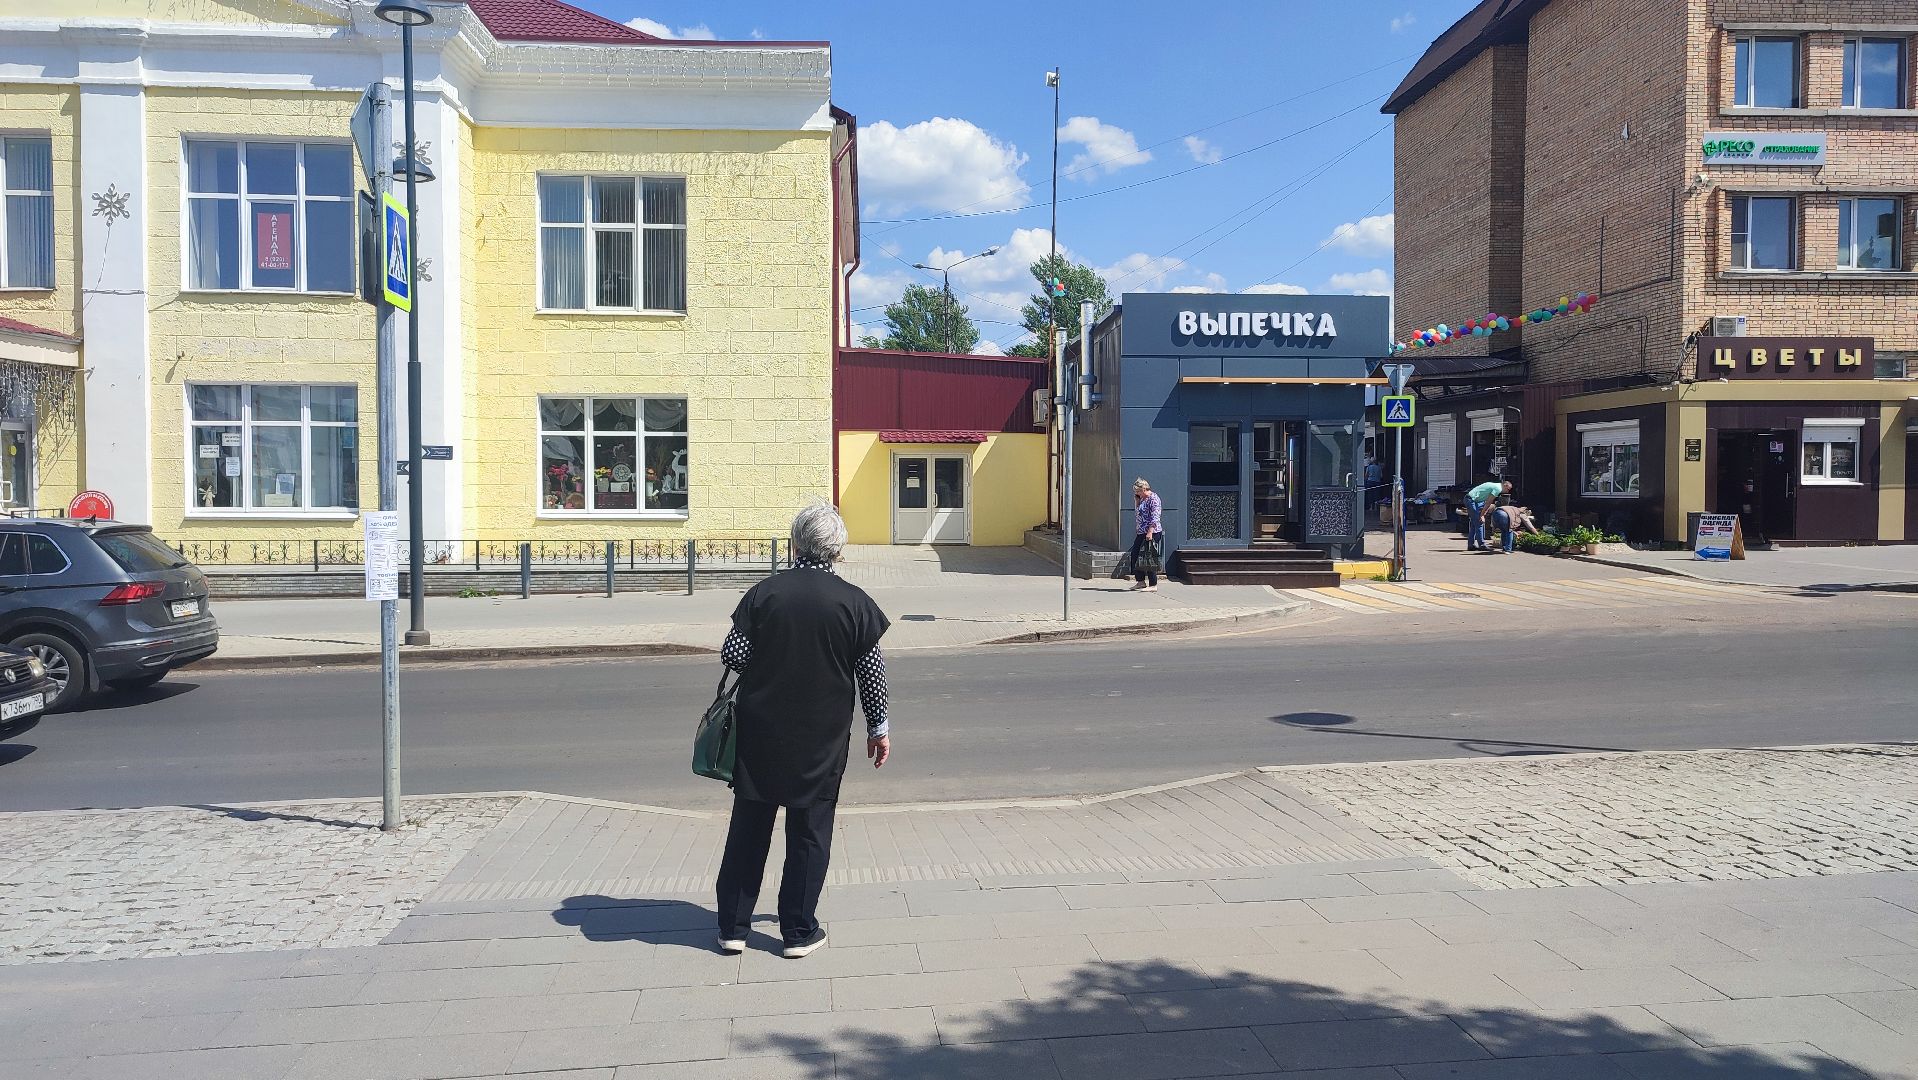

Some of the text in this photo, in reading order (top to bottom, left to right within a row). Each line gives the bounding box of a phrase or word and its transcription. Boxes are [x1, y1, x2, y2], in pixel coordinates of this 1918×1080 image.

[1719, 140, 1821, 153] РЕСО СТРАХОВАНИЕ
[270, 214, 279, 256] АРЕНДА
[1178, 310, 1338, 337] ВЫПЕЧКА
[1714, 348, 1862, 369] ЦВЕТЫ
